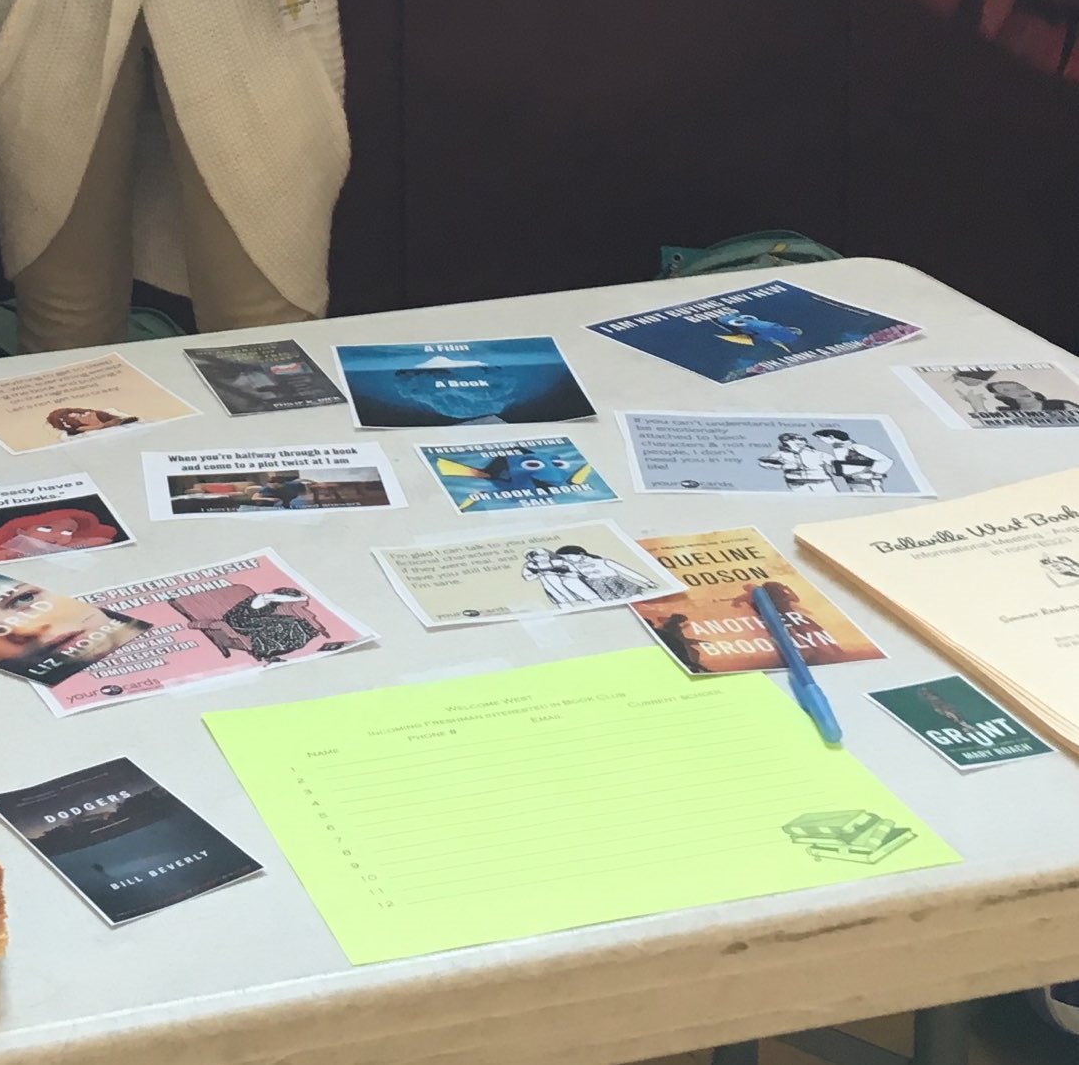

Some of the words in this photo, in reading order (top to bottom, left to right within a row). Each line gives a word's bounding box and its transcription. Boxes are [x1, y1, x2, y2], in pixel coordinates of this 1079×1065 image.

[609, 320, 639, 332] AM
[637, 312, 669, 326] NOT
[720, 293, 753, 306] ANY
[749, 284, 787, 298] NEW
[424, 345, 436, 353] A
[437, 343, 470, 352] Film
[435, 380, 447, 388] A
[450, 379, 490, 388] Book
[168, 454, 198, 463] When
[199, 451, 233, 463] you're
[235, 450, 277, 461] halfway
[279, 448, 321, 460] through
[332, 447, 359, 456] book
[181, 463, 201, 472] and
[203, 463, 233, 471] come
[234, 461, 246, 469] to
[257, 460, 281, 470] plot
[281, 458, 310, 467] twist
[312, 458, 324, 466] at
[333, 457, 350, 465] am
[37, 482, 74, 493] have
[469, 491, 492, 502] OH
[493, 488, 534, 500] LOOK
[536, 487, 548, 496] A
[548, 484, 594, 495] BOOK
[519, 497, 556, 507] SALE
[870, 528, 965, 555] Belleville
[967, 518, 1028, 542] West
[657, 545, 767, 570] QUELINE
[108, 573, 178, 601] PRETEND
[178, 568, 202, 585] TO
[201, 557, 261, 581] MYSELF
[681, 566, 771, 588] ODSON
[109, 593, 152, 613] HAVE
[152, 577, 234, 603] INSOMNIA
[152, 623, 184, 638] HAVE
[28, 657, 64, 676] LIZ
[60, 618, 129, 658] MOORE
[119, 646, 174, 669] RESPECT
[172, 640, 199, 655] FOR
[147, 635, 176, 651] AND
[697, 629, 839, 657] BROOLYN
[89, 658, 167, 681] TOMORROW
[925, 717, 1018, 747] GRUNT
[961, 749, 994, 761] MARY
[994, 742, 1034, 757] ROACH
[43, 789, 133, 824] DODGERS
[109, 875, 143, 891] BILL
[148, 849, 210, 878] BEVERLY
